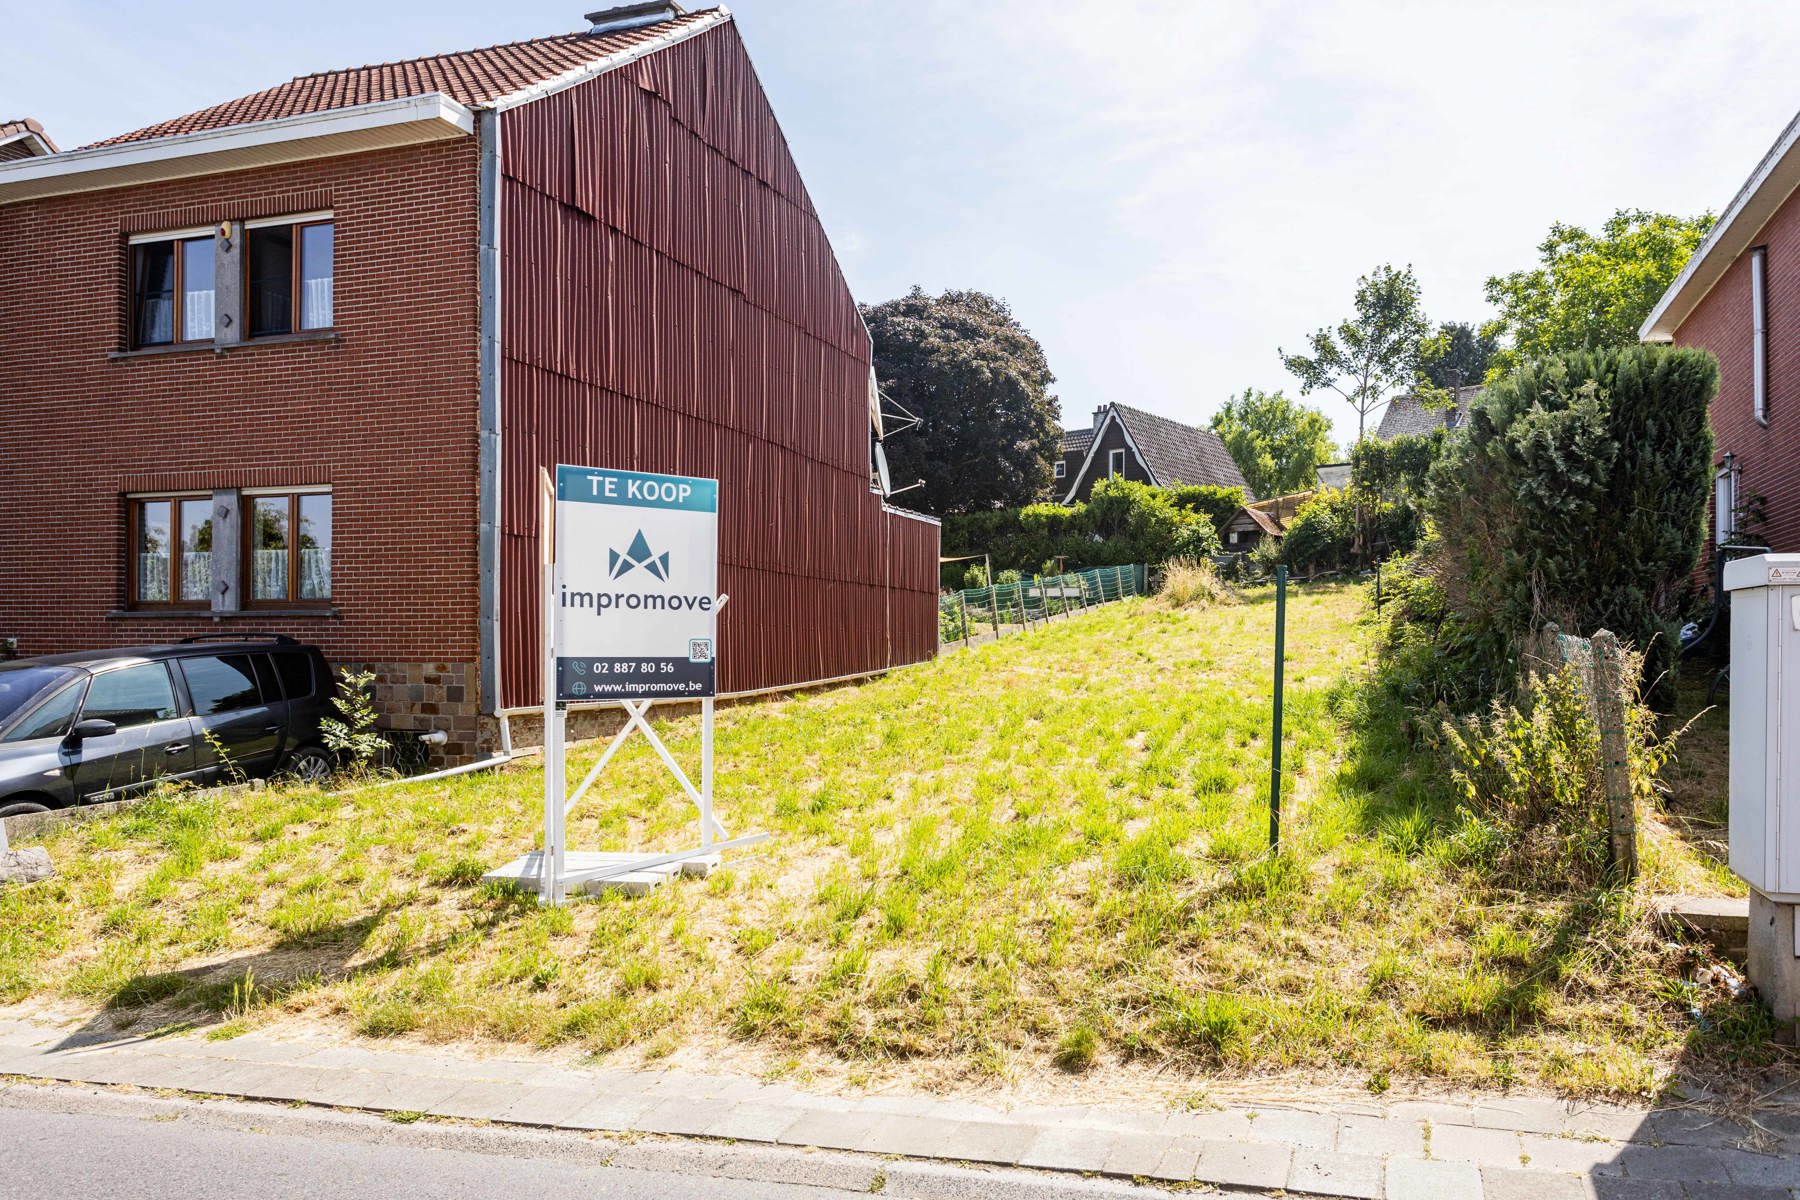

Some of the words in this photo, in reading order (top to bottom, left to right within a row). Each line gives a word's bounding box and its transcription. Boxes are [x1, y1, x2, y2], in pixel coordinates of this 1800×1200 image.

[587, 475, 618, 497] TE
[627, 479, 691, 502] KOOP
[561, 584, 712, 616] impromove
[593, 662, 609, 673] 02
[613, 662, 636, 673] 887
[640, 662, 656, 673] 80
[660, 662, 675, 673] 56
[593, 681, 702, 693] www.impromove.be
